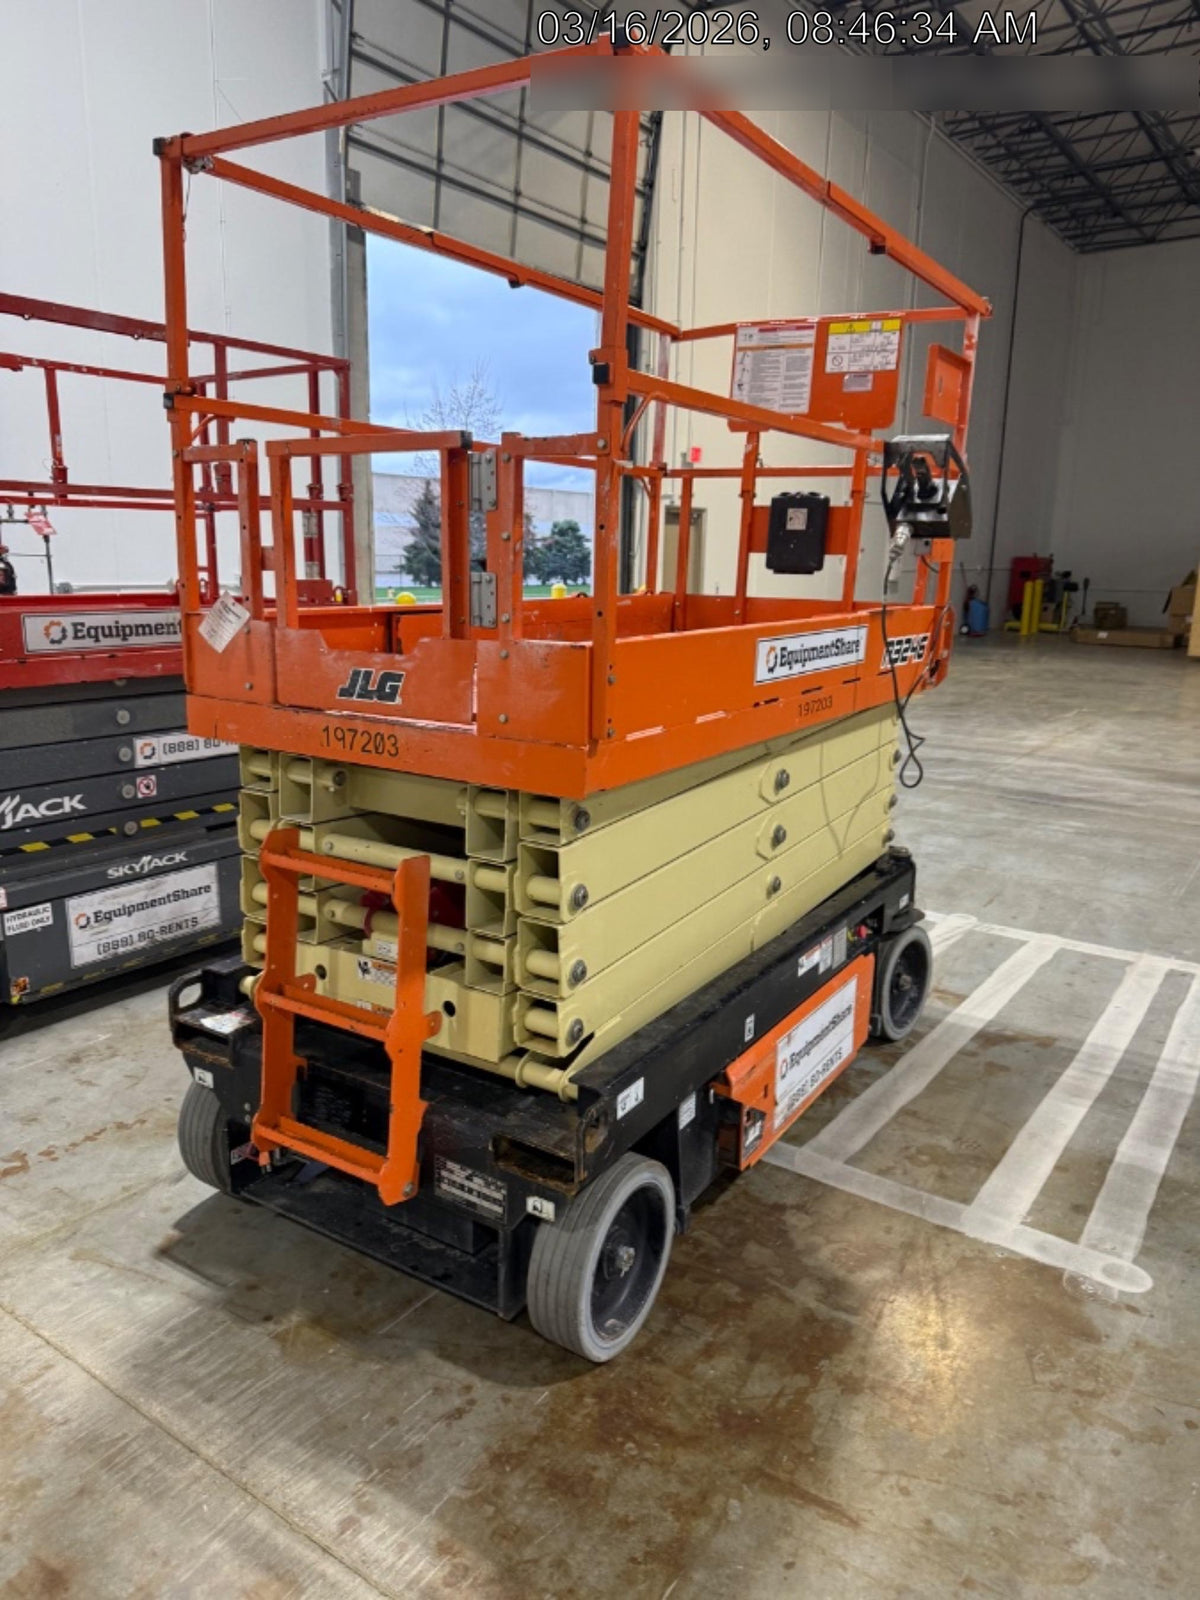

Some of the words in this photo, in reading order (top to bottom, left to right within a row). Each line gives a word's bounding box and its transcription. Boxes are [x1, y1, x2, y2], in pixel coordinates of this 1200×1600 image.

[778, 637, 861, 671] EquipmentShare
[336, 667, 405, 705] JLG
[797, 696, 833, 718] 197203
[322, 725, 400, 758] 197203
[106, 851, 189, 879] SKYJACK
[93, 884, 213, 924] EquipmentShare
[137, 916, 200, 943] 80-RENTS
